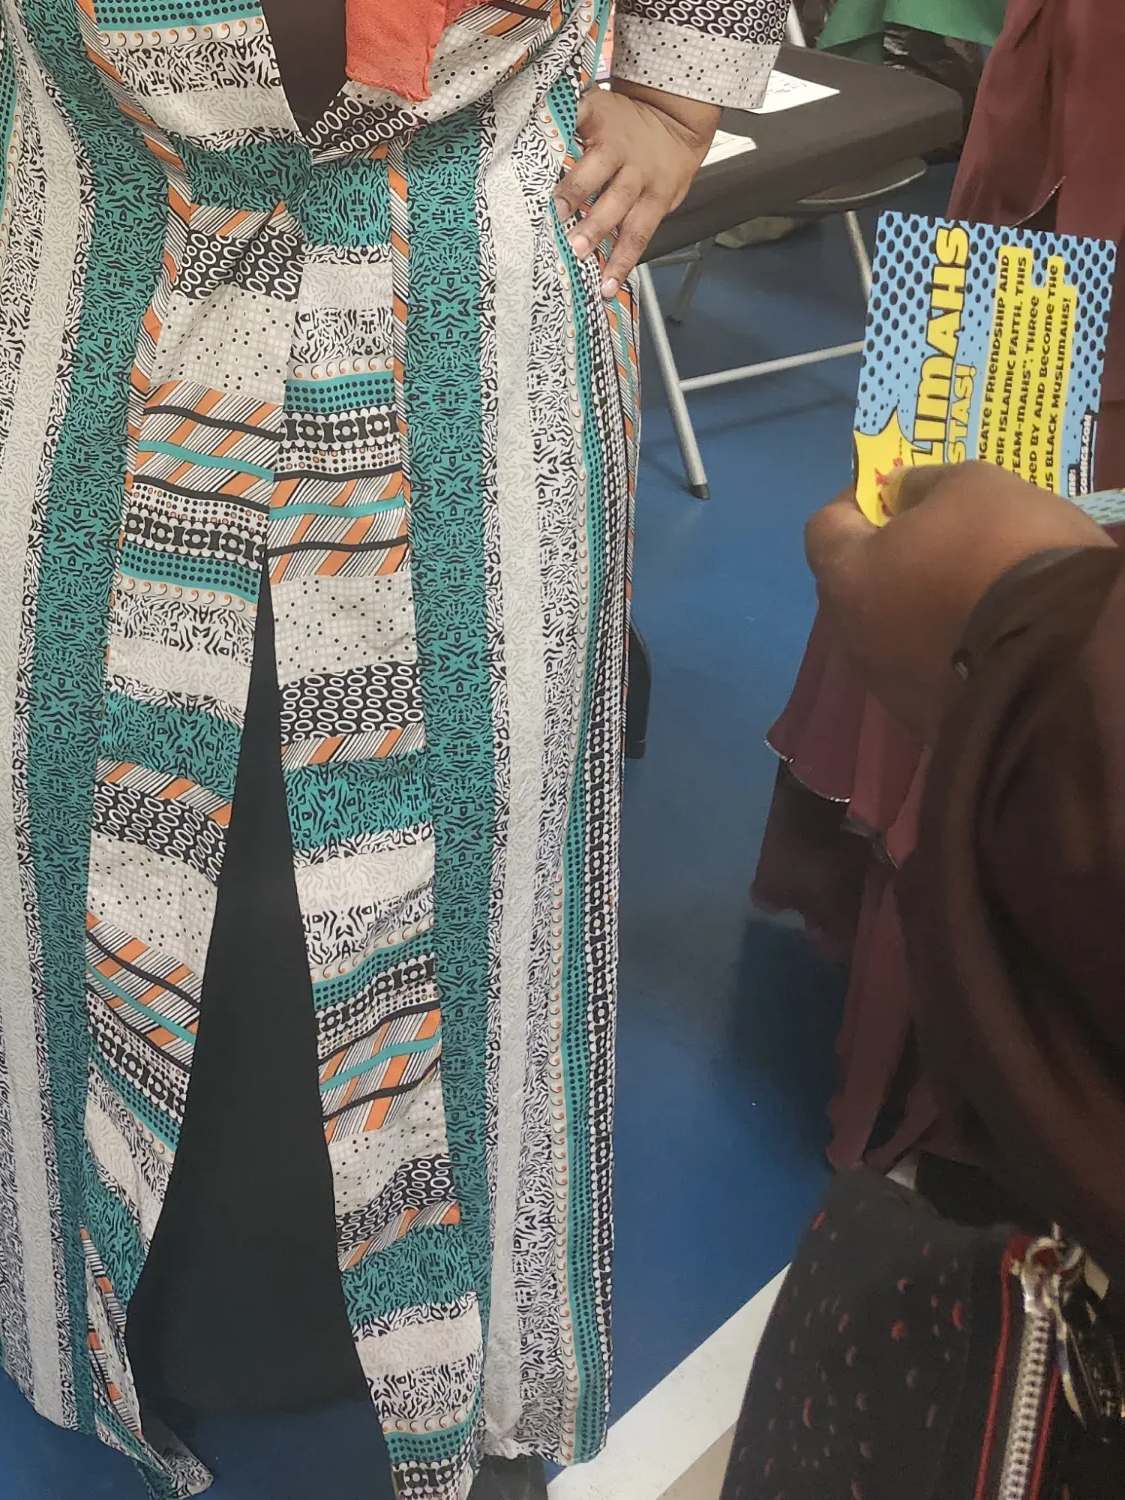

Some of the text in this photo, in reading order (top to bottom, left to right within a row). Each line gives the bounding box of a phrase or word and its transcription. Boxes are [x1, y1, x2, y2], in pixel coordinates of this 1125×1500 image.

[999, 255, 1010, 293] AND
[1047, 264, 1058, 299] THE
[998, 359, 1016, 432] ISLAMIC
[1015, 257, 1027, 296] THIS
[1025, 295, 1040, 354] THREE
[1051, 297, 1072, 408] MUSLIMAHS!
[1033, 382, 1046, 419] AND
[1030, 423, 1040, 446] BY
[1045, 413, 1058, 468] BLACK
